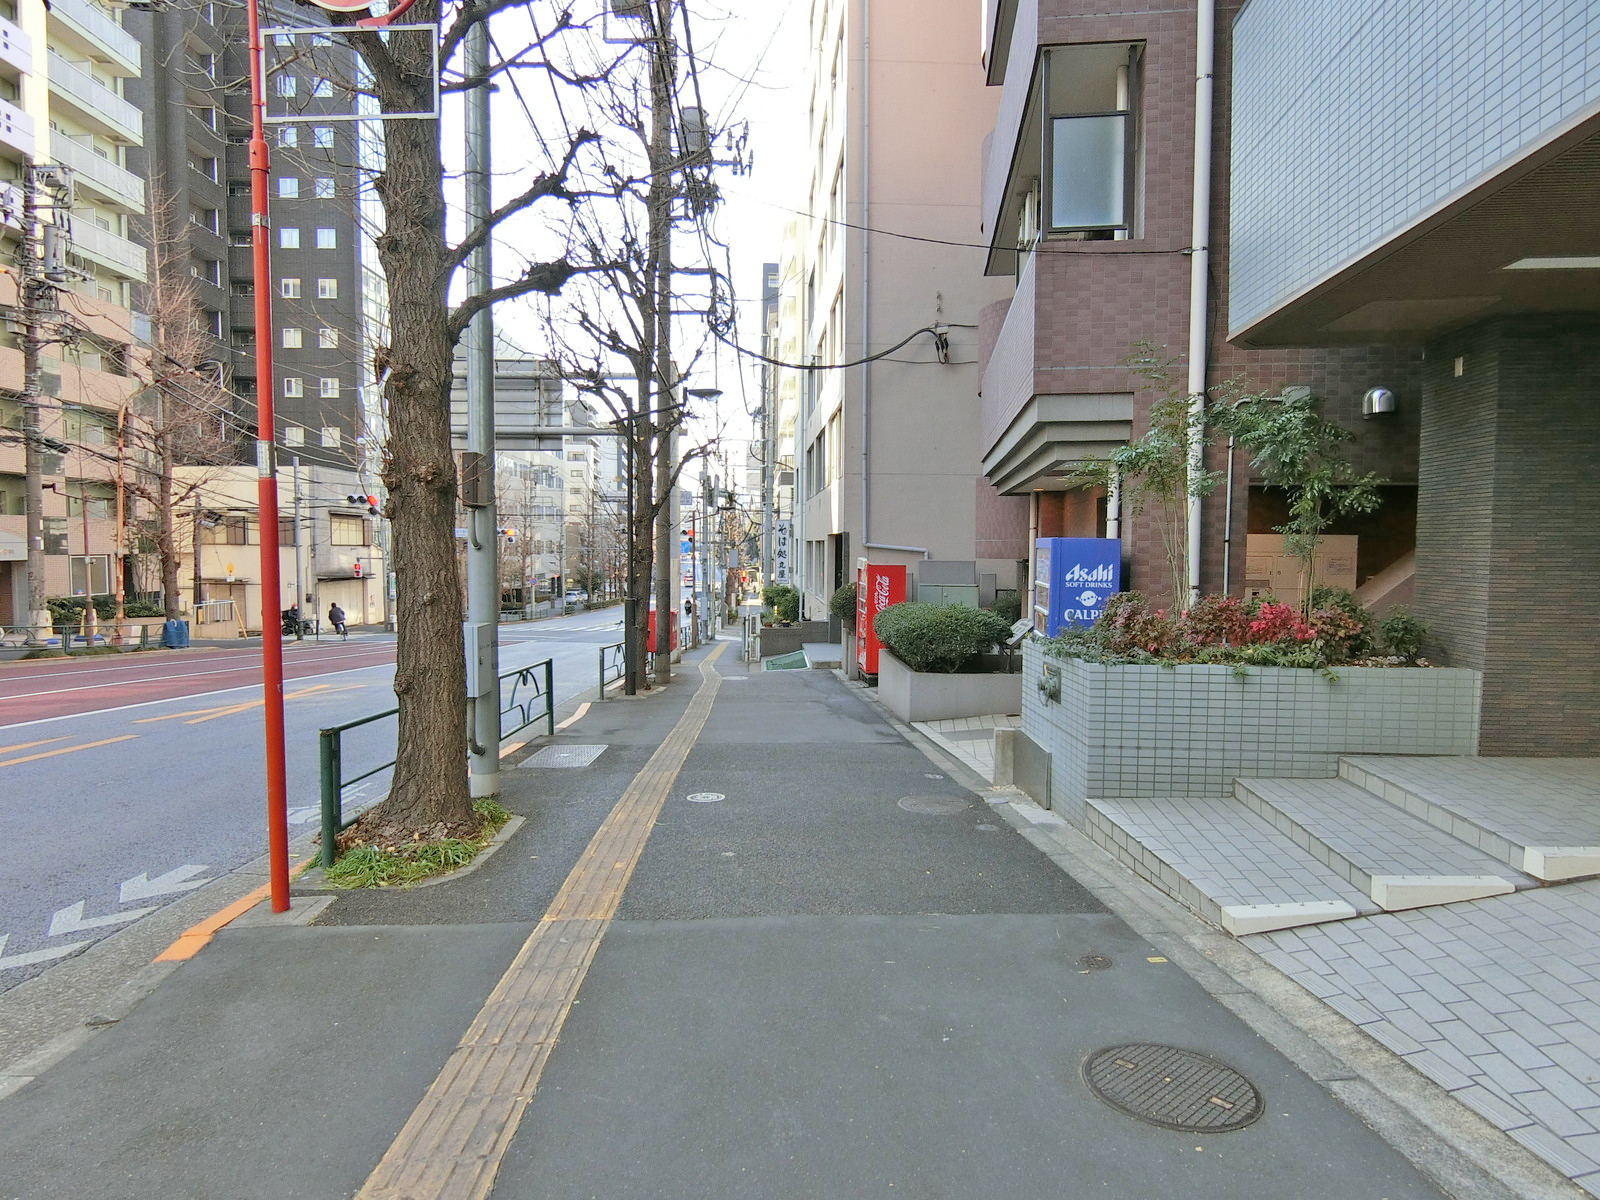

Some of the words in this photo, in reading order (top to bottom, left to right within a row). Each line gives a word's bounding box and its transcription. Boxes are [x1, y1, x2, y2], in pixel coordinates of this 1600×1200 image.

[1065, 563, 1113, 582] Asahi
[1085, 581, 1113, 589] DRINKS
[1064, 608, 1103, 622] CALPI
